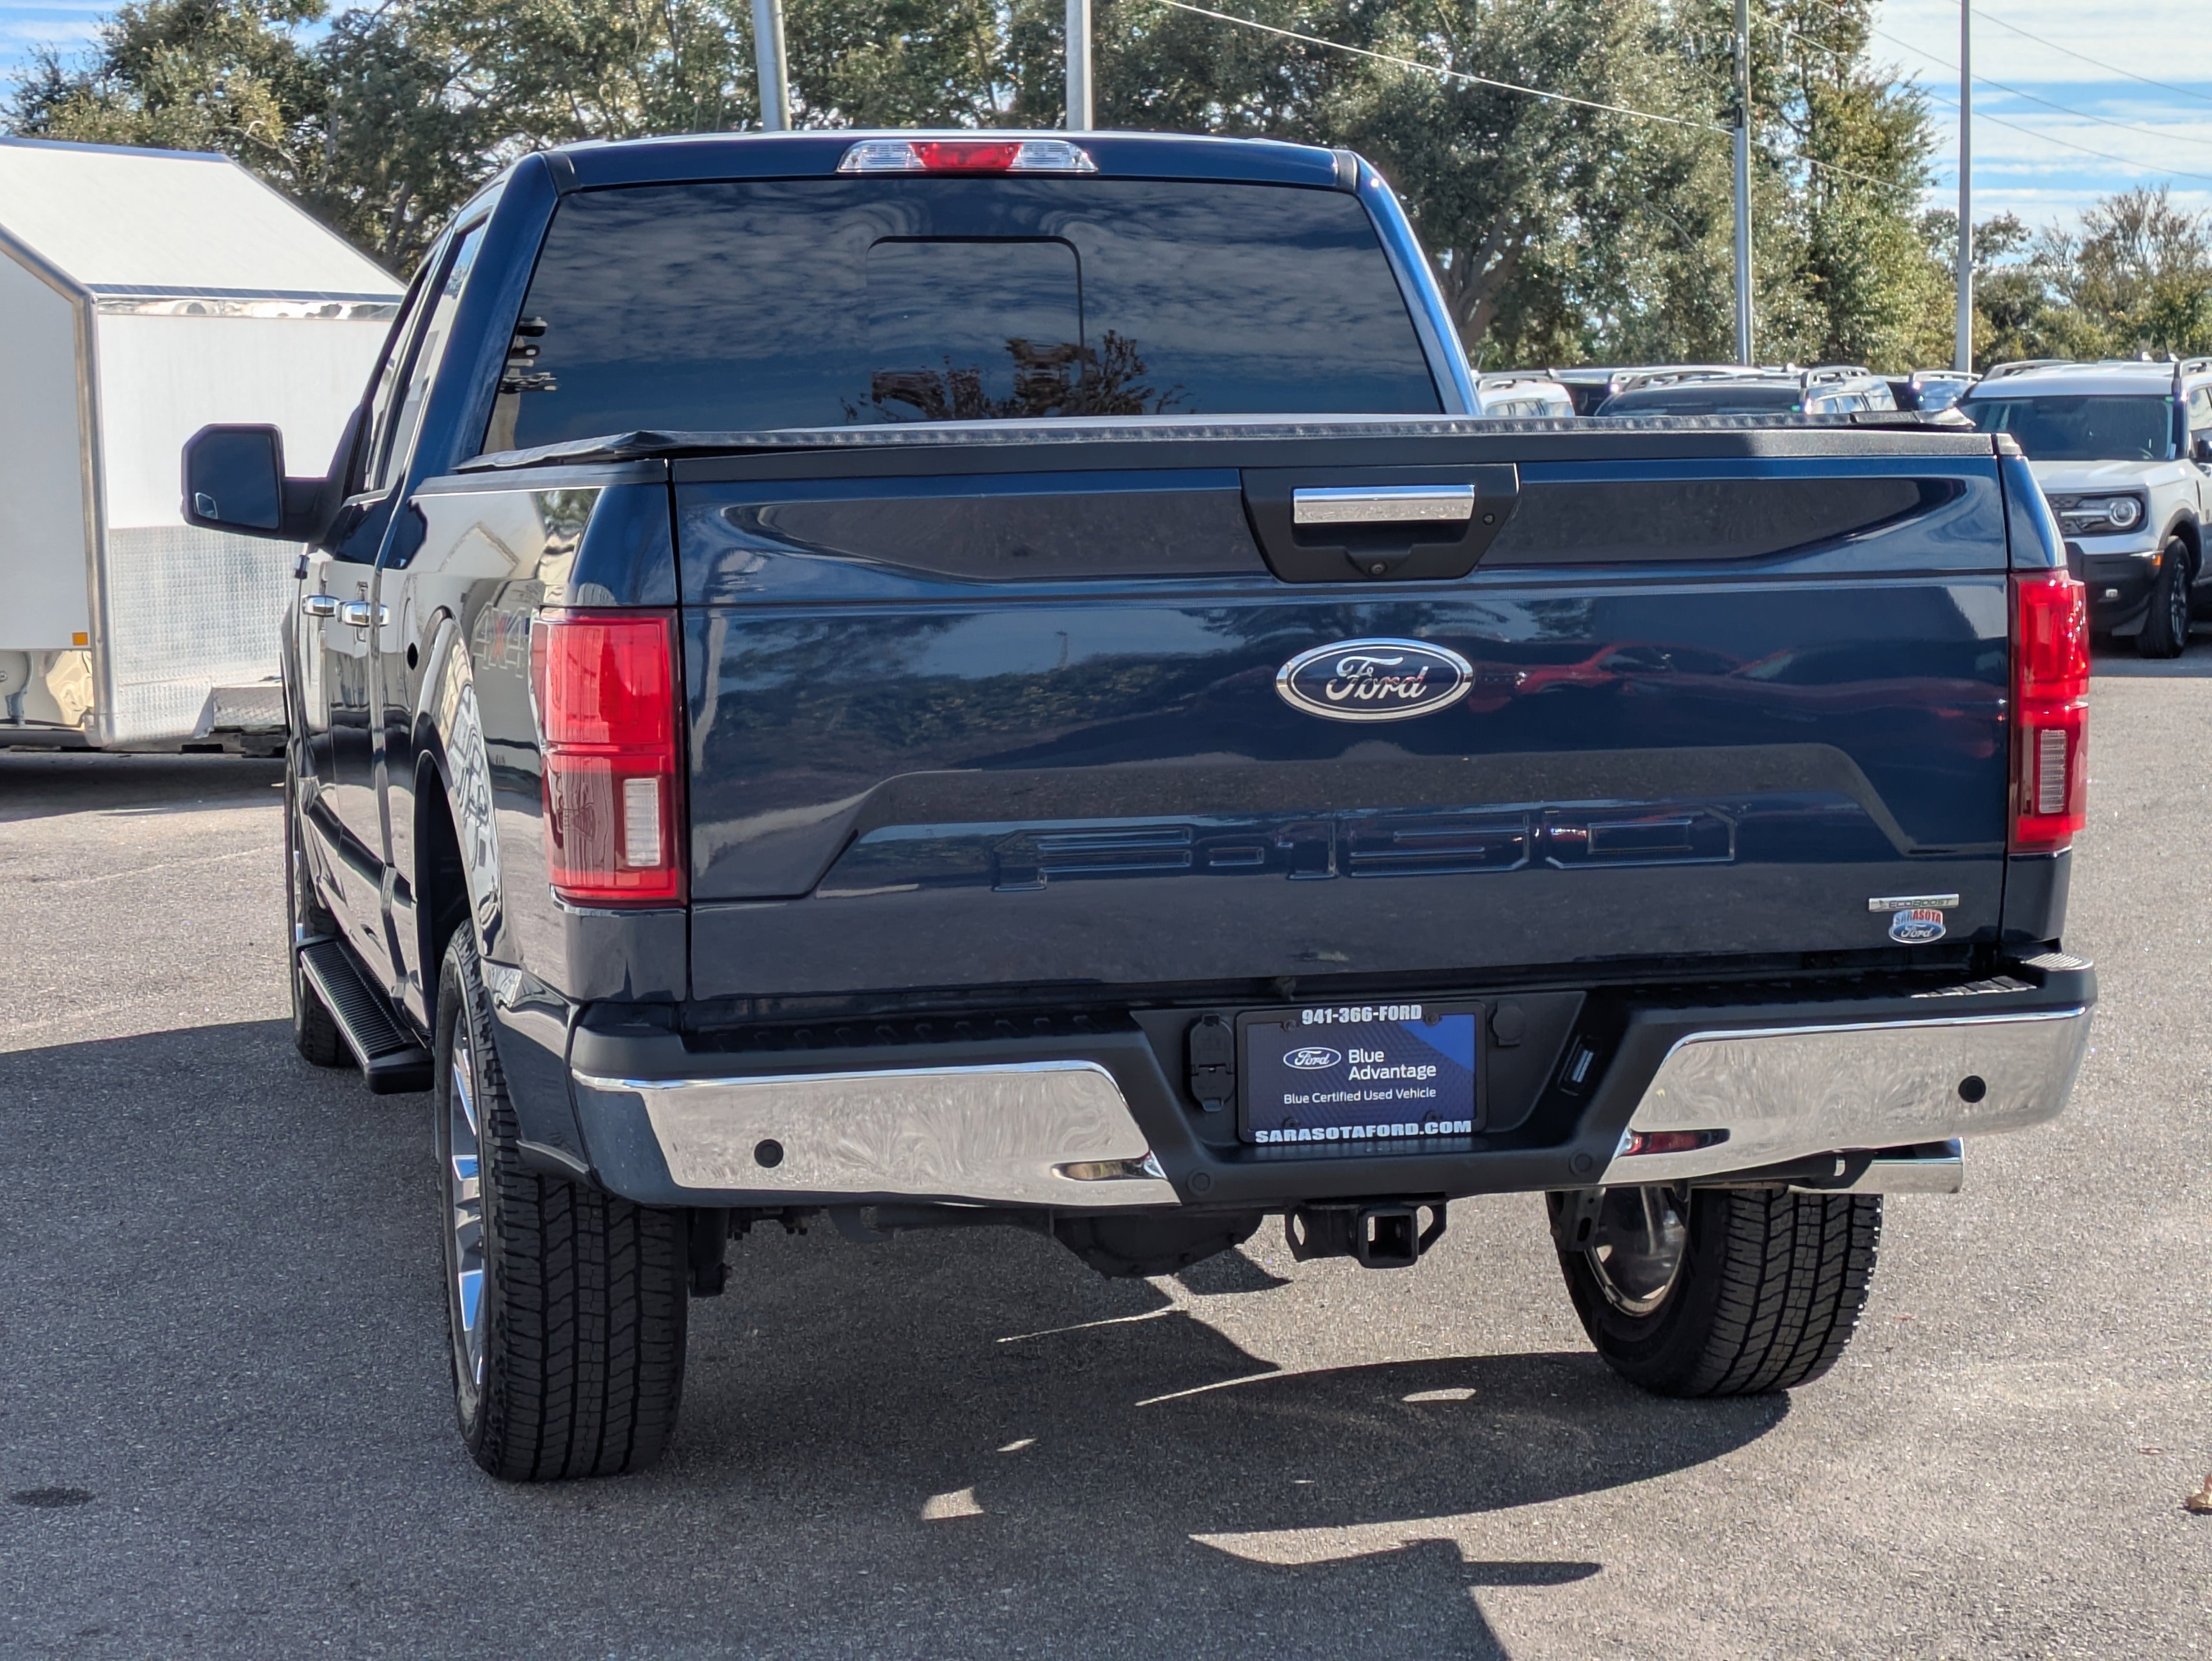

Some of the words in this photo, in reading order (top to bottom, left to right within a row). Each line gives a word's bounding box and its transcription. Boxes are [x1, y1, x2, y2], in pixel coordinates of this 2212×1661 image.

[1326, 656, 1429, 700] Ford
[1895, 910, 1941, 925] SARASOTA
[1901, 924, 1934, 938] Ford
[1302, 1005, 1422, 1025] 941-366-FORD
[1294, 1051, 1330, 1066] Ford
[1349, 1049, 1384, 1064] Blue
[1349, 1063, 1437, 1081] Advantage
[1283, 1093, 1310, 1104] Blue
[1312, 1090, 1361, 1103] Certified
[1364, 1089, 1394, 1100] Used
[1395, 1087, 1437, 1099] Vehicle
[1255, 1120, 1471, 1143] SARASOTAFORD.COM
